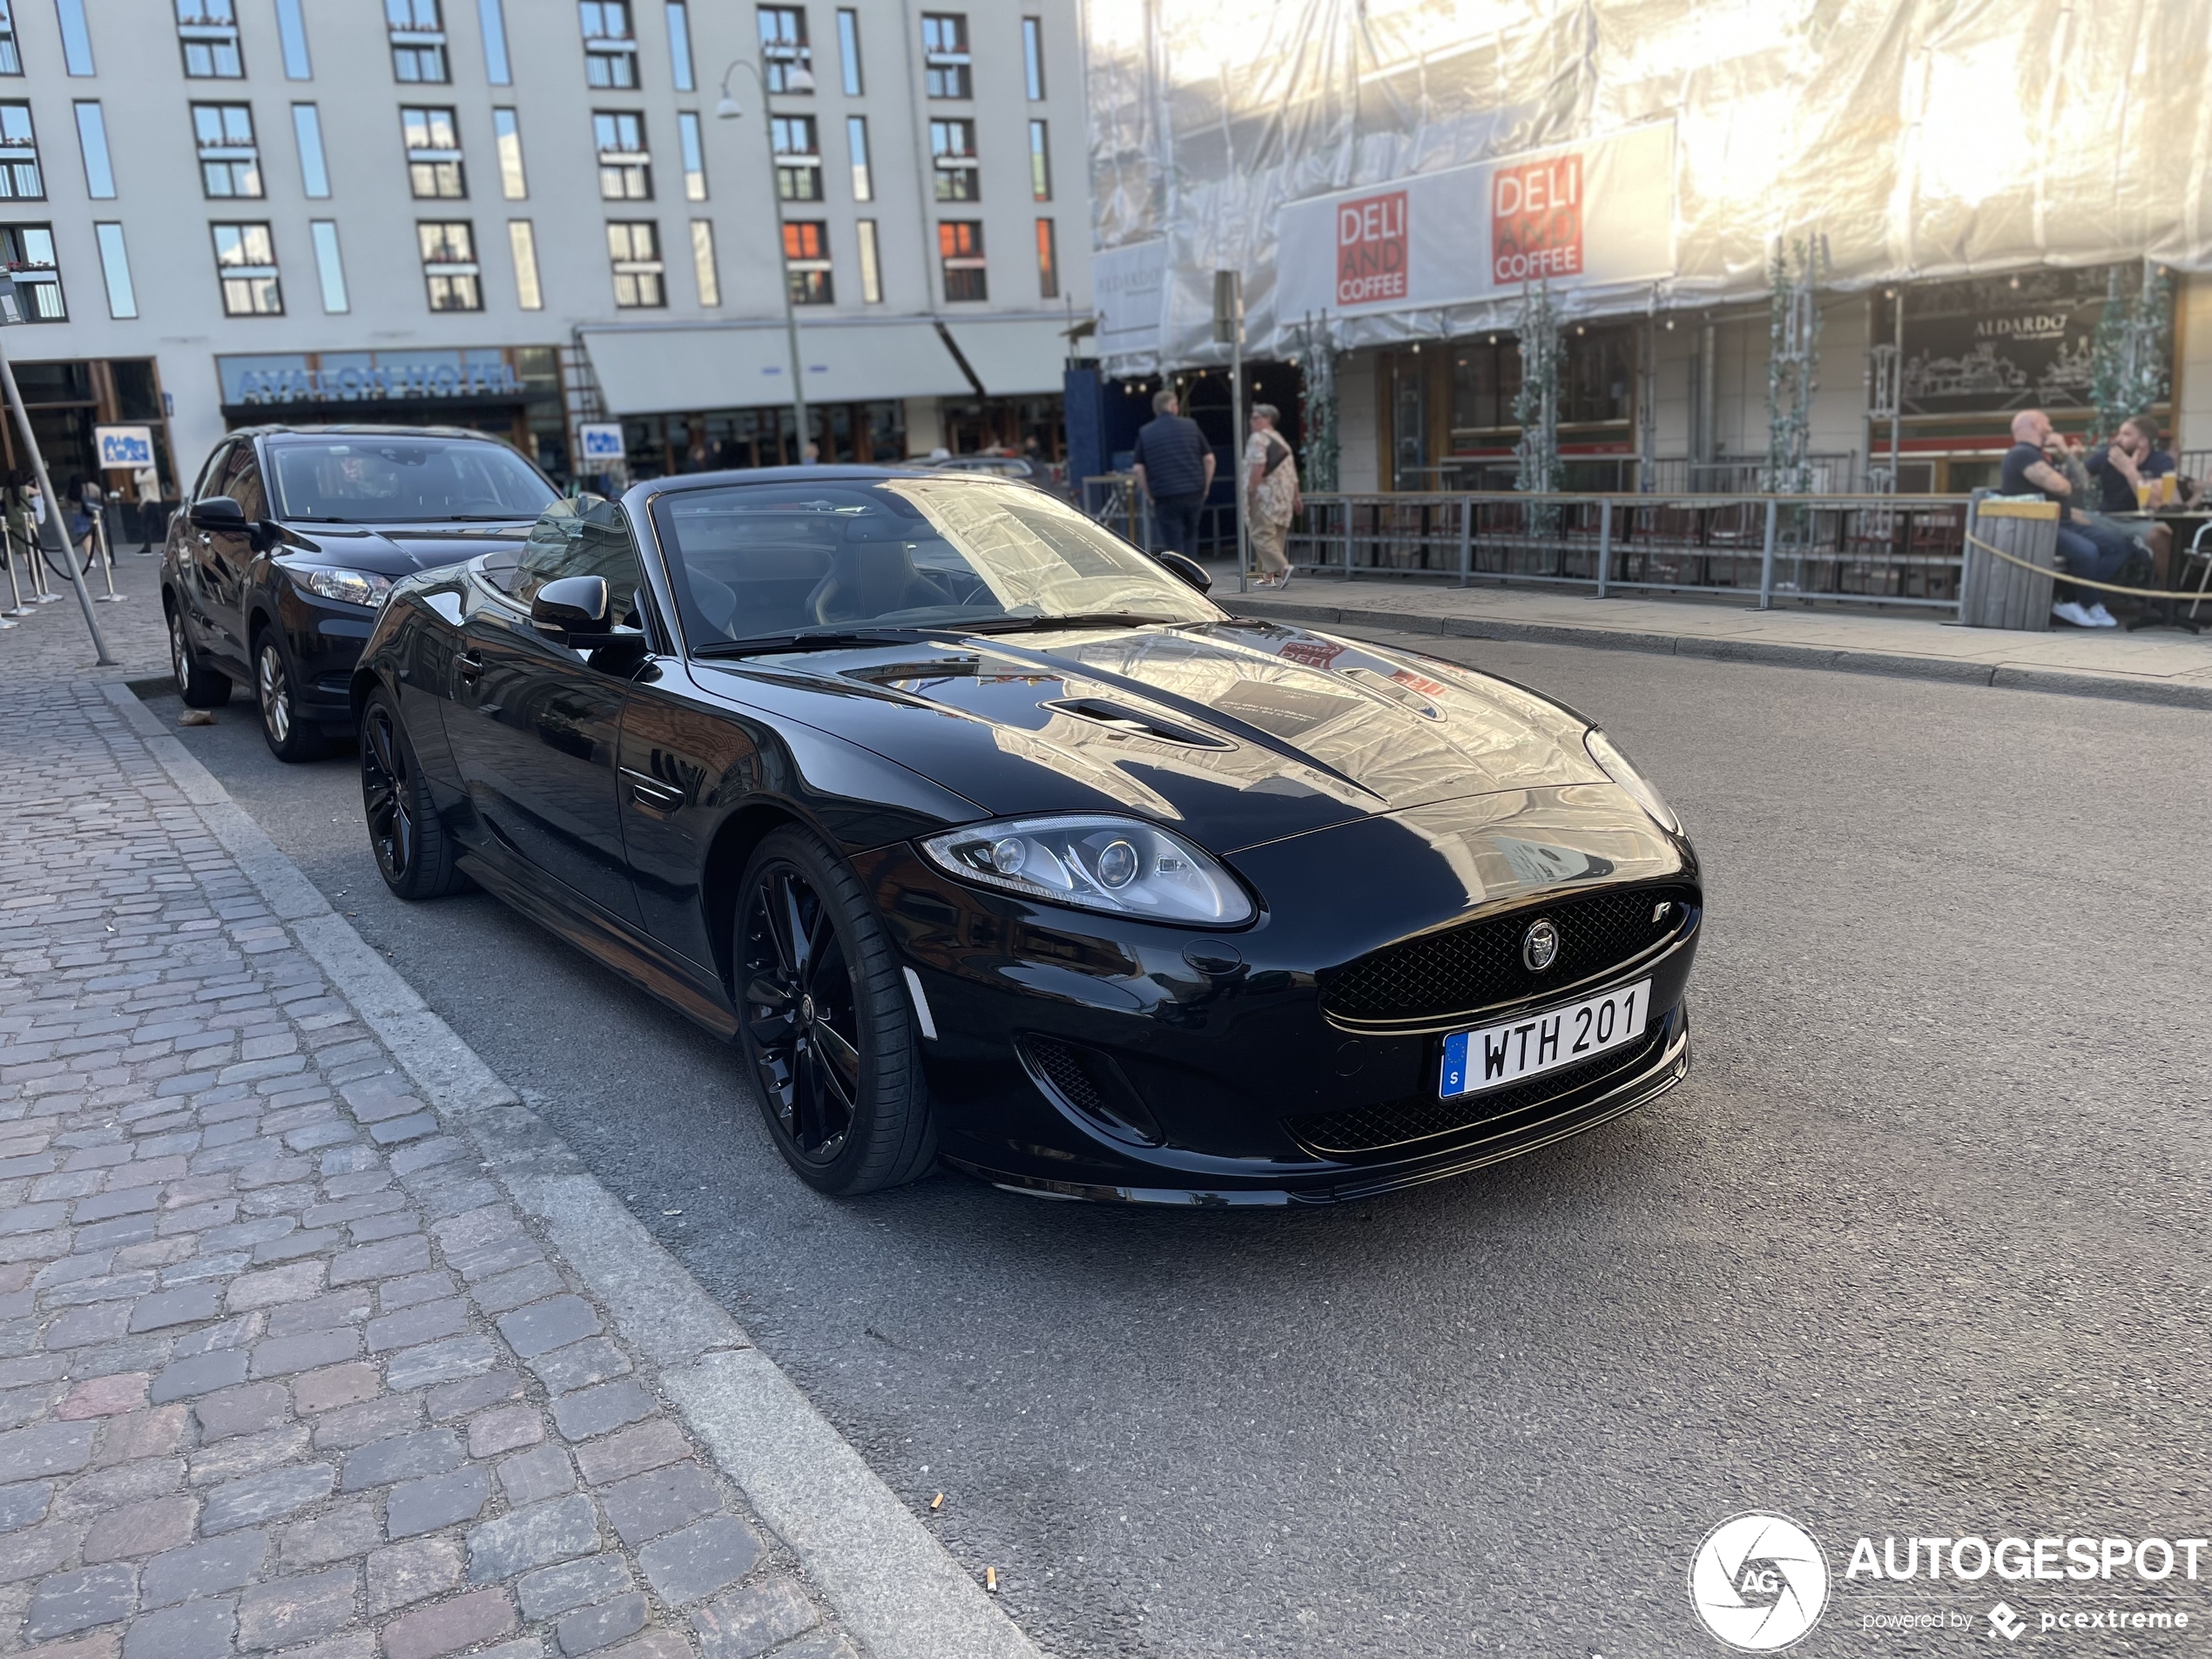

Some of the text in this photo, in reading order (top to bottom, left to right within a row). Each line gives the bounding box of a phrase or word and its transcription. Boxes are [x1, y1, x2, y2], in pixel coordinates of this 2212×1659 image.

[1495, 162, 1576, 218] DELI
[1340, 199, 1404, 246] DELI
[1498, 208, 1576, 254] AND
[1341, 238, 1403, 279] AND
[1495, 245, 1578, 280] COFFEE
[1339, 272, 1404, 301] COFFEE
[238, 362, 527, 398] AVALON HOTEL
[1484, 990, 1635, 1081] WTH 201
[1449, 1071, 1459, 1084] S
